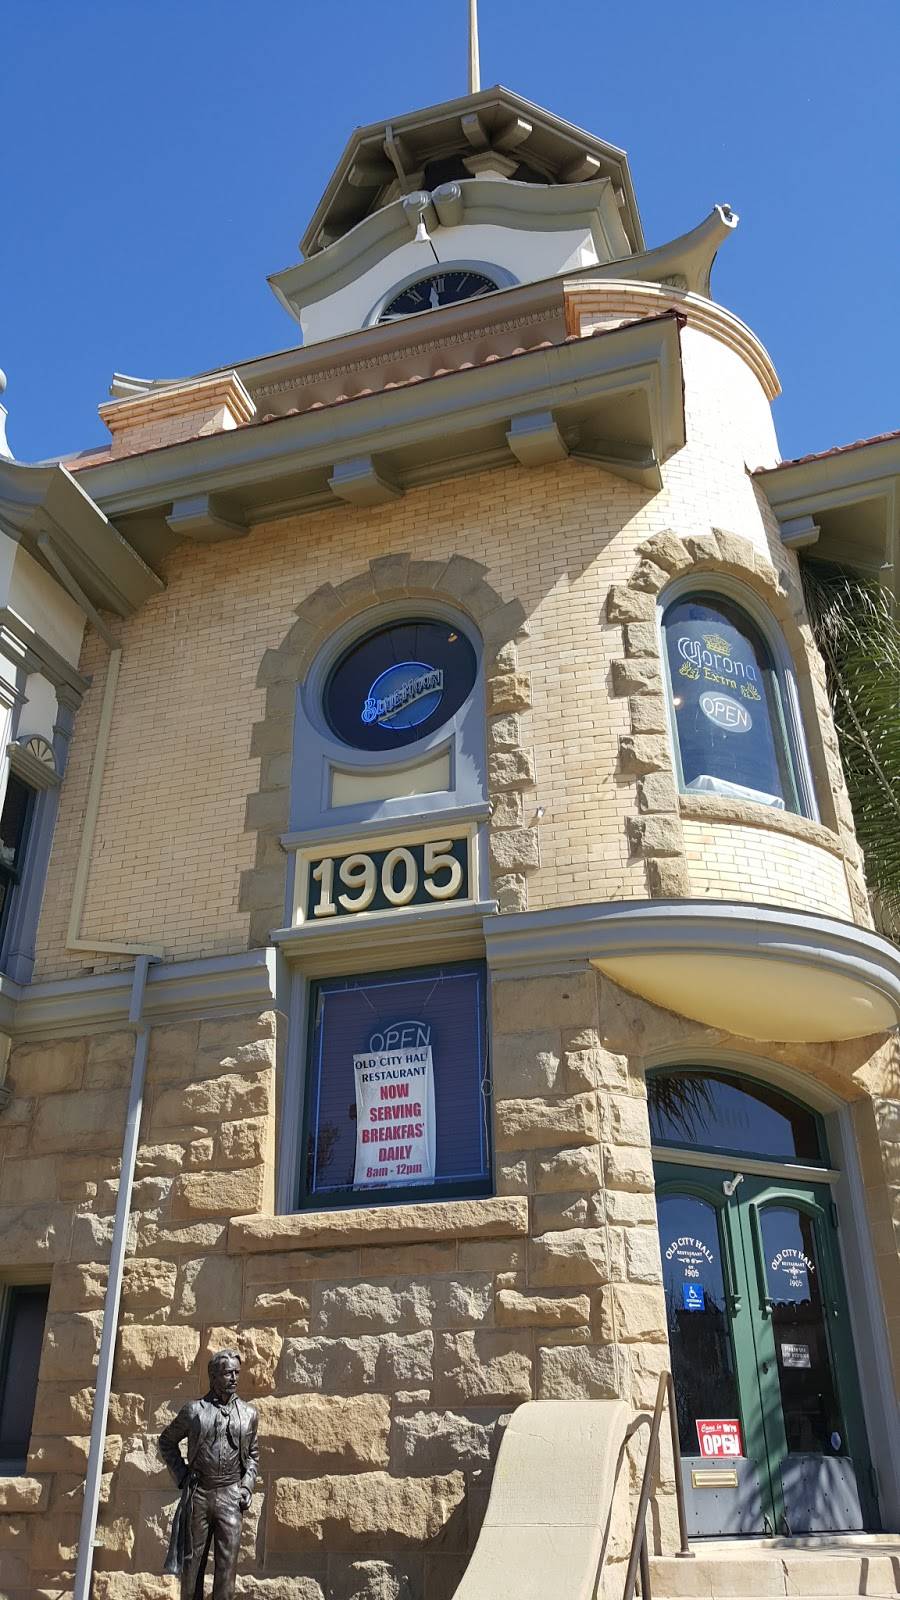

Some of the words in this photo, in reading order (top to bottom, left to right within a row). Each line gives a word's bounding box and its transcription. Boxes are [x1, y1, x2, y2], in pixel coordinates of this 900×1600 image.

[678, 637, 757, 682] Corona
[702, 697, 748, 726] OPEN
[312, 839, 463, 917] 1905
[370, 1024, 430, 1052] OPEN
[355, 1059, 376, 1070] OLD
[380, 1055, 402, 1067] CITY
[405, 1052, 428, 1063] HAL
[361, 1066, 426, 1083] RESTAURANT
[380, 1083, 409, 1100] NOW
[370, 1103, 421, 1122] SERVING
[362, 1124, 425, 1144] BREAKFAS
[379, 1145, 413, 1162] DAILY
[366, 1167, 388, 1177] 8am
[396, 1163, 422, 1176] 12pm
[665, 1242, 678, 1260] OLD
[678, 1237, 695, 1247] CITY
[695, 1240, 714, 1264] HALL
[771, 1253, 783, 1270] OLD
[781, 1249, 798, 1258] CITY
[798, 1251, 816, 1274] HALL
[703, 1435, 740, 1455] OPEN
